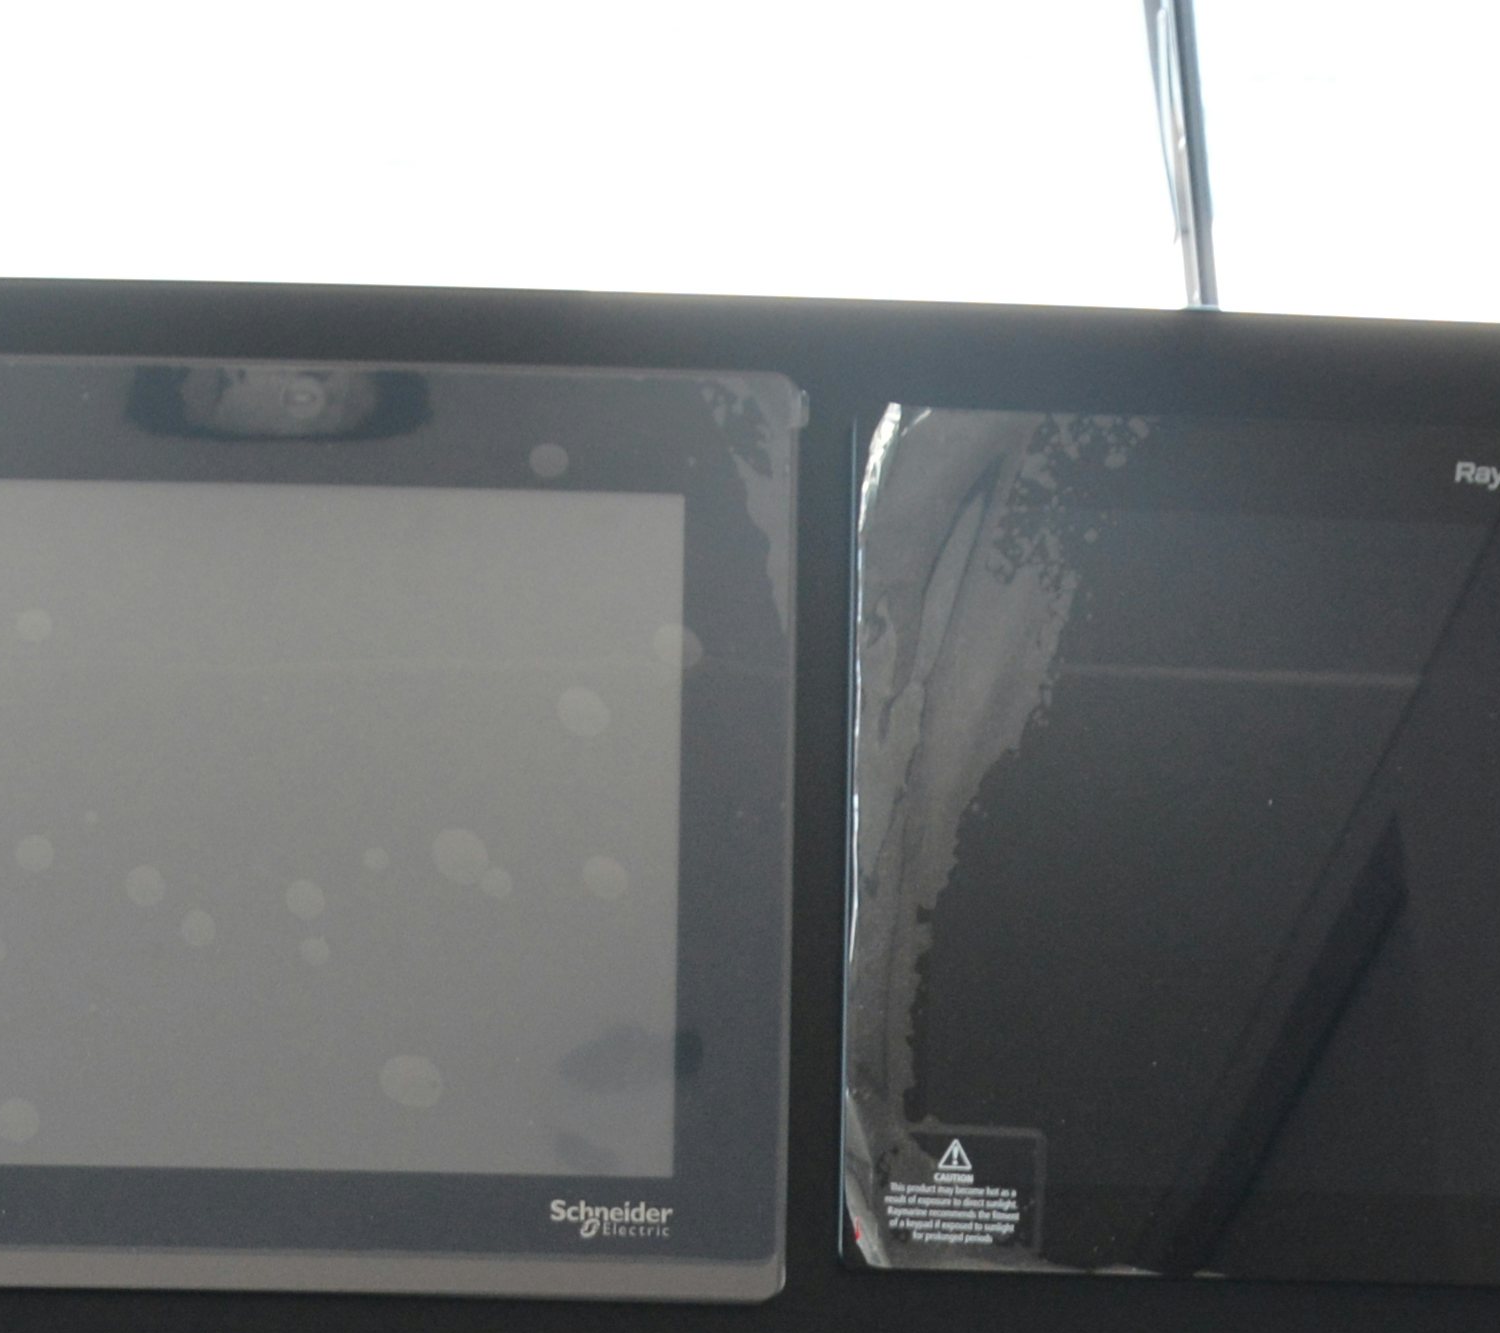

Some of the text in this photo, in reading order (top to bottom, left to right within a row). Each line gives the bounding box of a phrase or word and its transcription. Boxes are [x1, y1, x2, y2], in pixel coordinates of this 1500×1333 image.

[934, 1172, 974, 1183] CAUTION
[550, 1199, 674, 1223] Schneider
[602, 1223, 670, 1237] Electric
